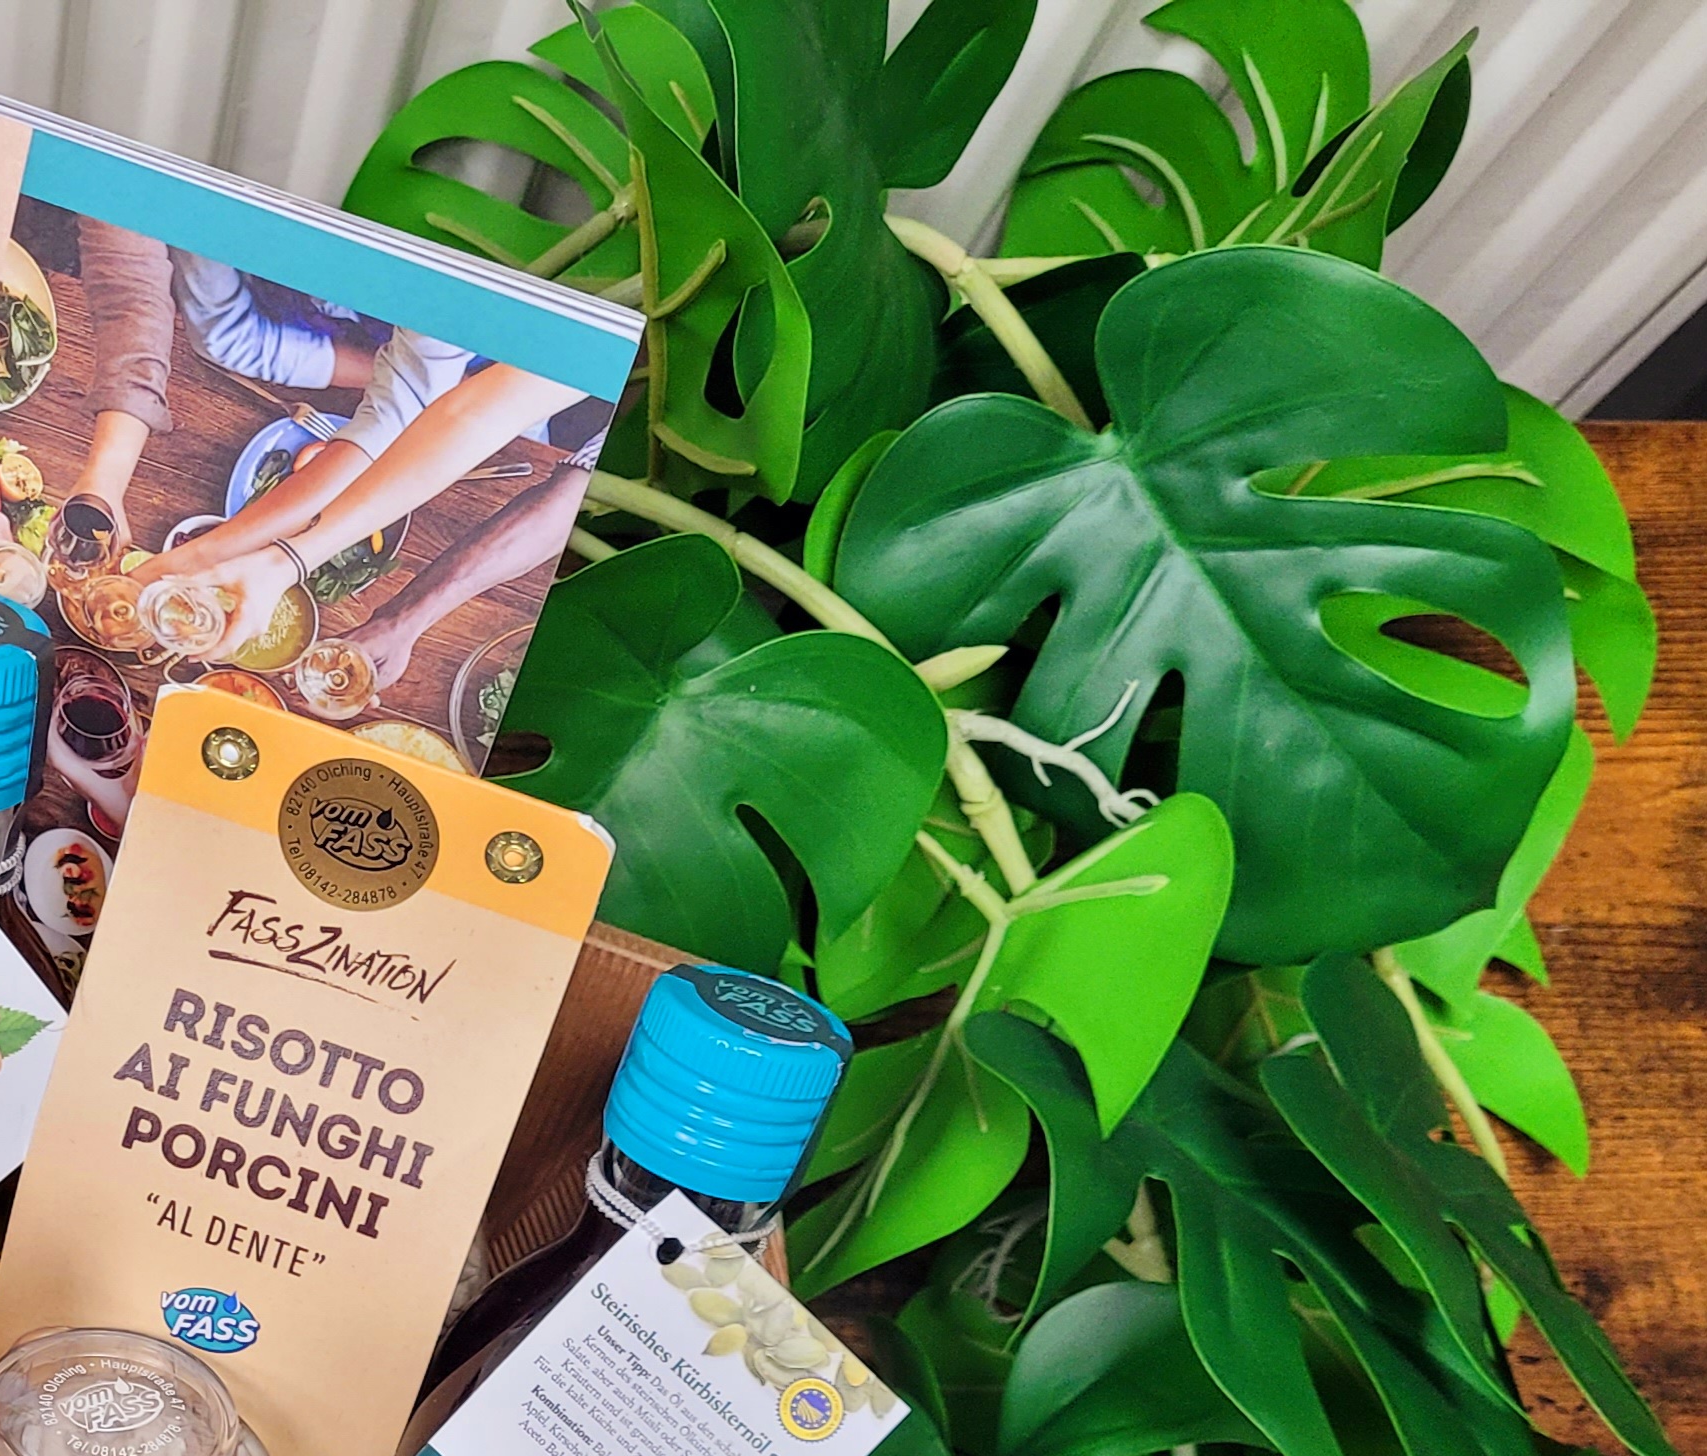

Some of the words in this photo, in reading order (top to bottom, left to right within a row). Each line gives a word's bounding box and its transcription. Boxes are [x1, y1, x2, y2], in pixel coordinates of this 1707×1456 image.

[286, 778, 317, 816] 82140
[317, 763, 372, 781] Olching
[411, 862, 426, 880] 47
[310, 798, 372, 828] vom
[314, 823, 413, 864] FASS
[719, 980, 776, 1003] vom
[718, 992, 818, 1033] FASS
[163, 987, 425, 1116] RISOTTO
[113, 1043, 189, 1102] AI
[199, 1068, 435, 1189] FUNGHI
[121, 1106, 390, 1239] PORCINI
[160, 1290, 216, 1315] vom
[170, 1311, 260, 1346] FASS
[590, 1282, 672, 1363] Steirisches
[669, 1357, 773, 1454] Kürbiskernöl
[597, 1324, 627, 1355] Unser
[626, 1351, 652, 1380] Tipp:
[43, 1364, 86, 1392] Olching
[101, 1359, 176, 1396] Hauptstraße
[39, 1394, 58, 1426] 82140
[58, 1388, 113, 1417] vom
[85, 1391, 164, 1433] FASS
[170, 1398, 185, 1411] 47
[530, 1384, 594, 1446] Kombination:
[517, 1419, 547, 1446] Aceto
